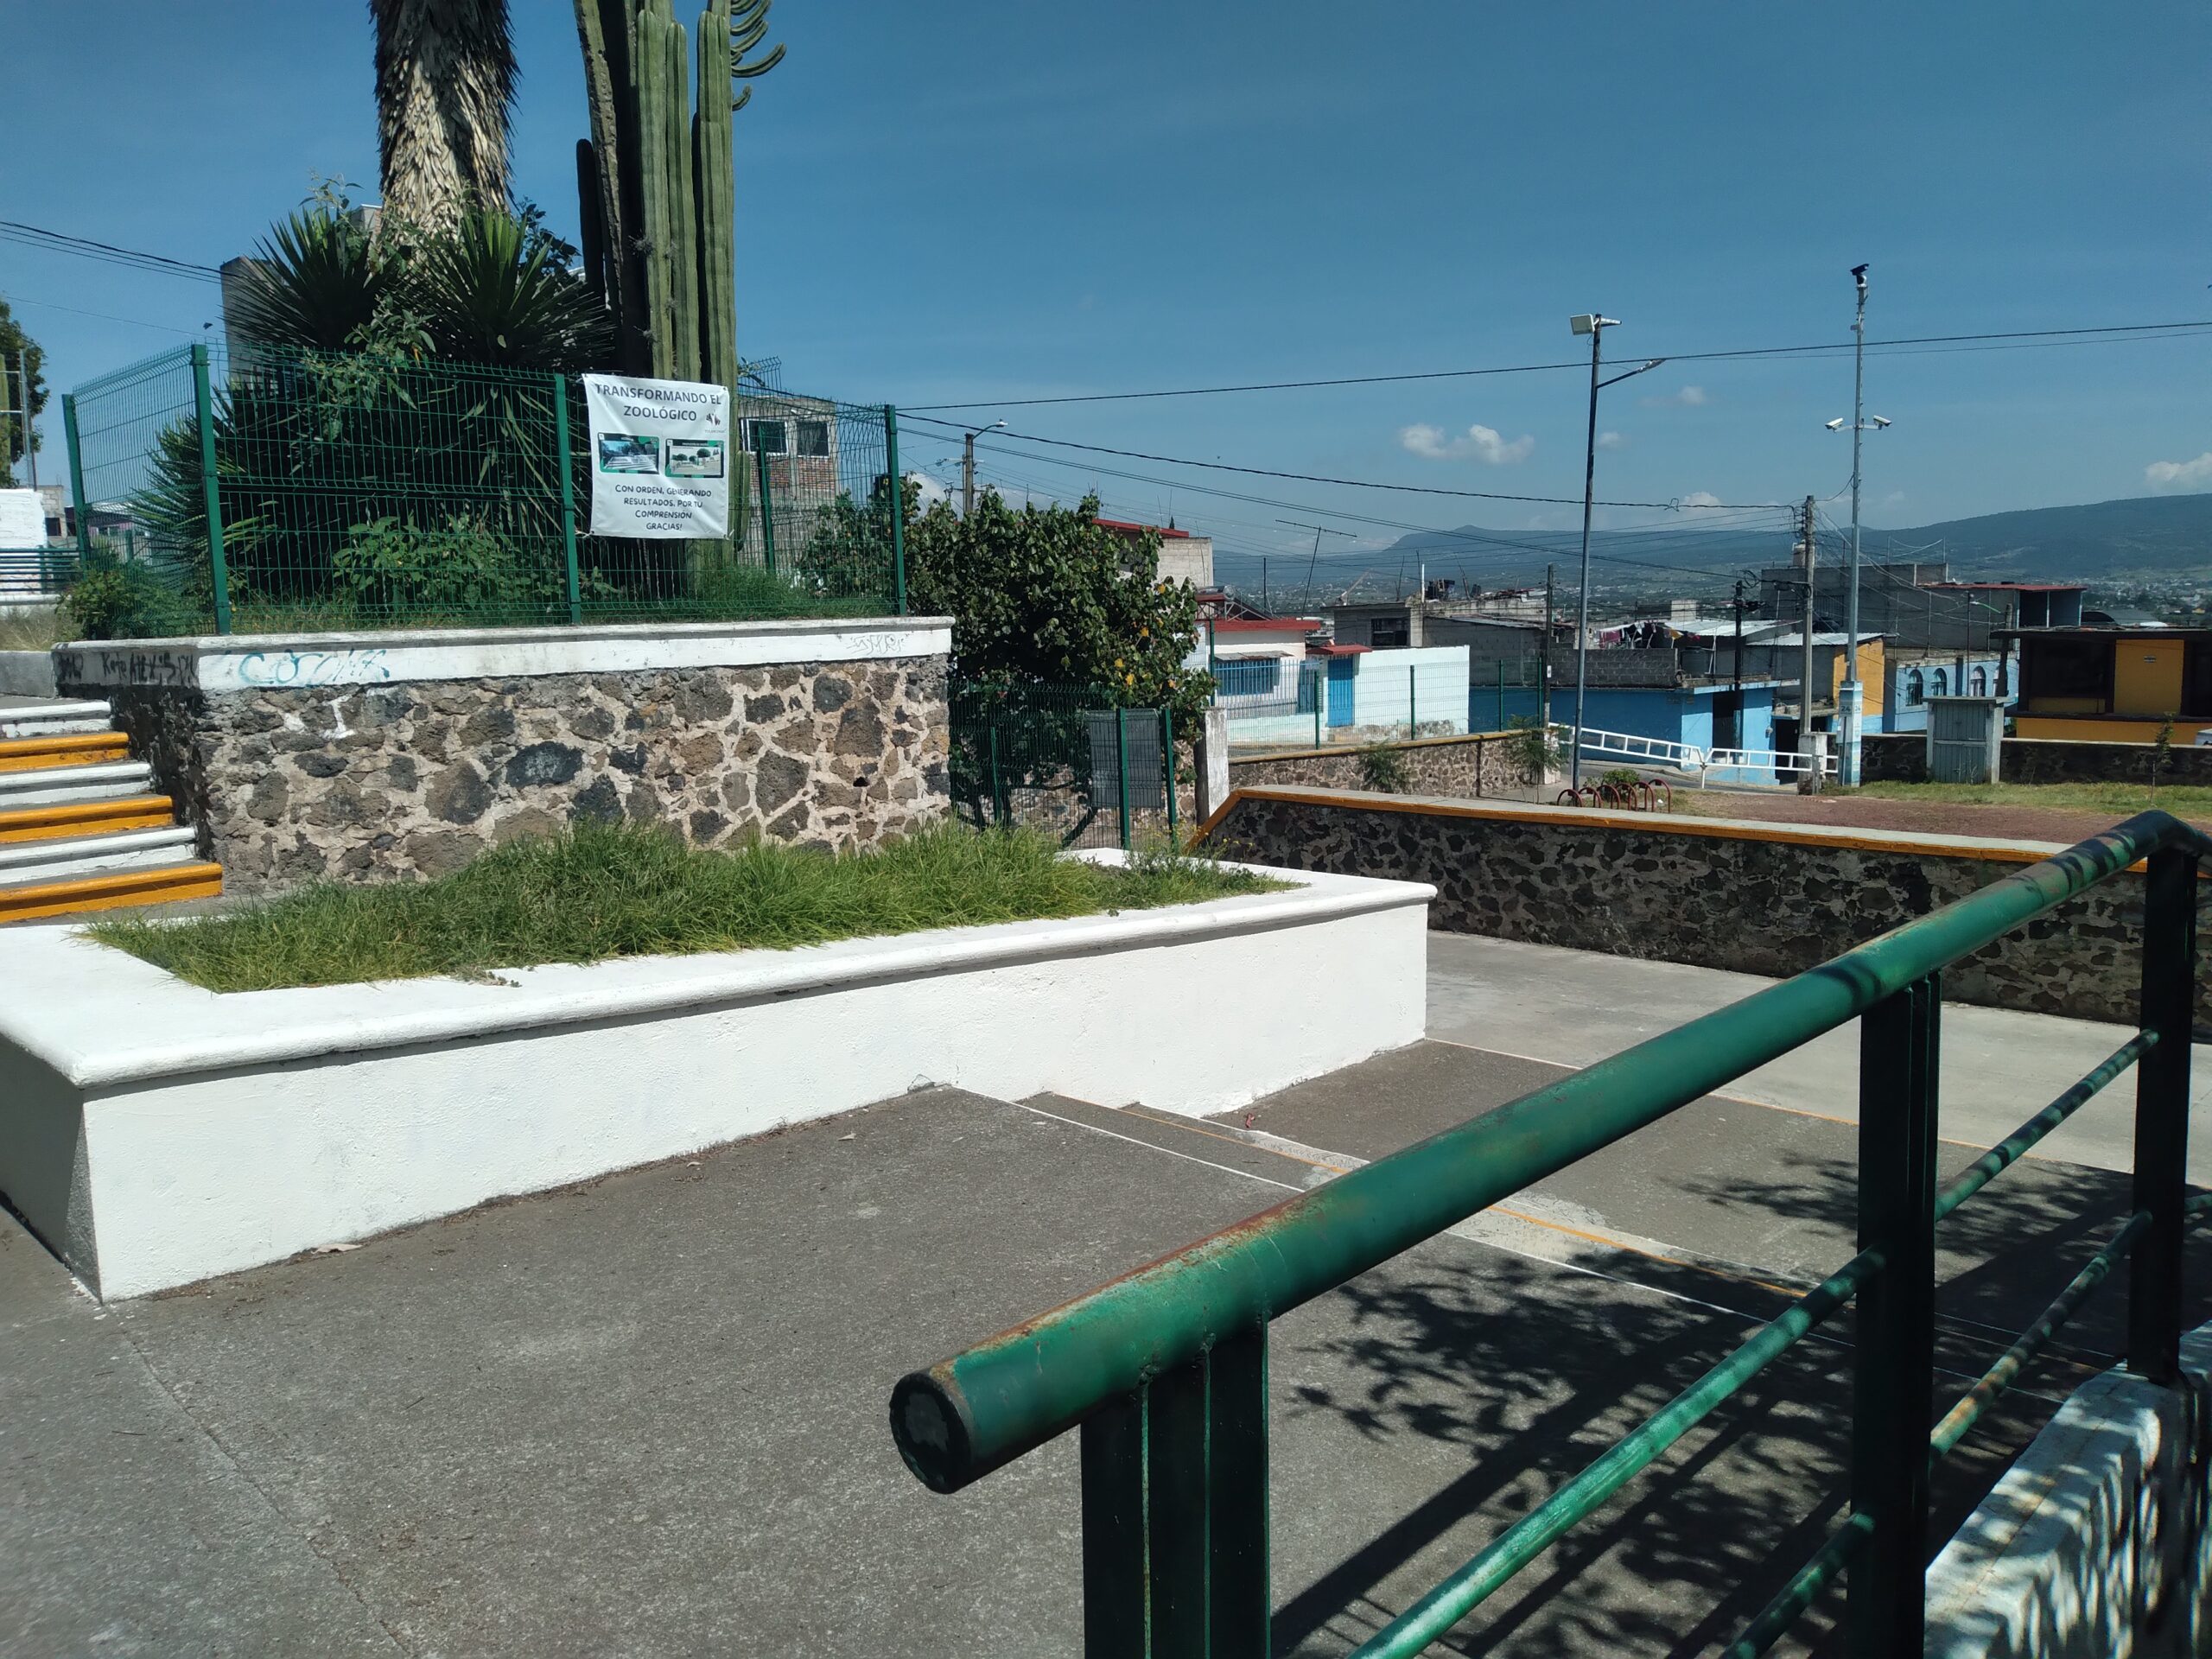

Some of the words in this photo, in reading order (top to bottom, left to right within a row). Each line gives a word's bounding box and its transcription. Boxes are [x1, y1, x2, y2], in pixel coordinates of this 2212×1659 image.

[595, 384, 707, 404] TRANSFORMANDO
[709, 394, 721, 404] EL
[624, 406, 696, 421] ZOOLÓGICO
[667, 487, 711, 497] GENERANDO
[635, 510, 692, 518] COMPRENSIÓN
